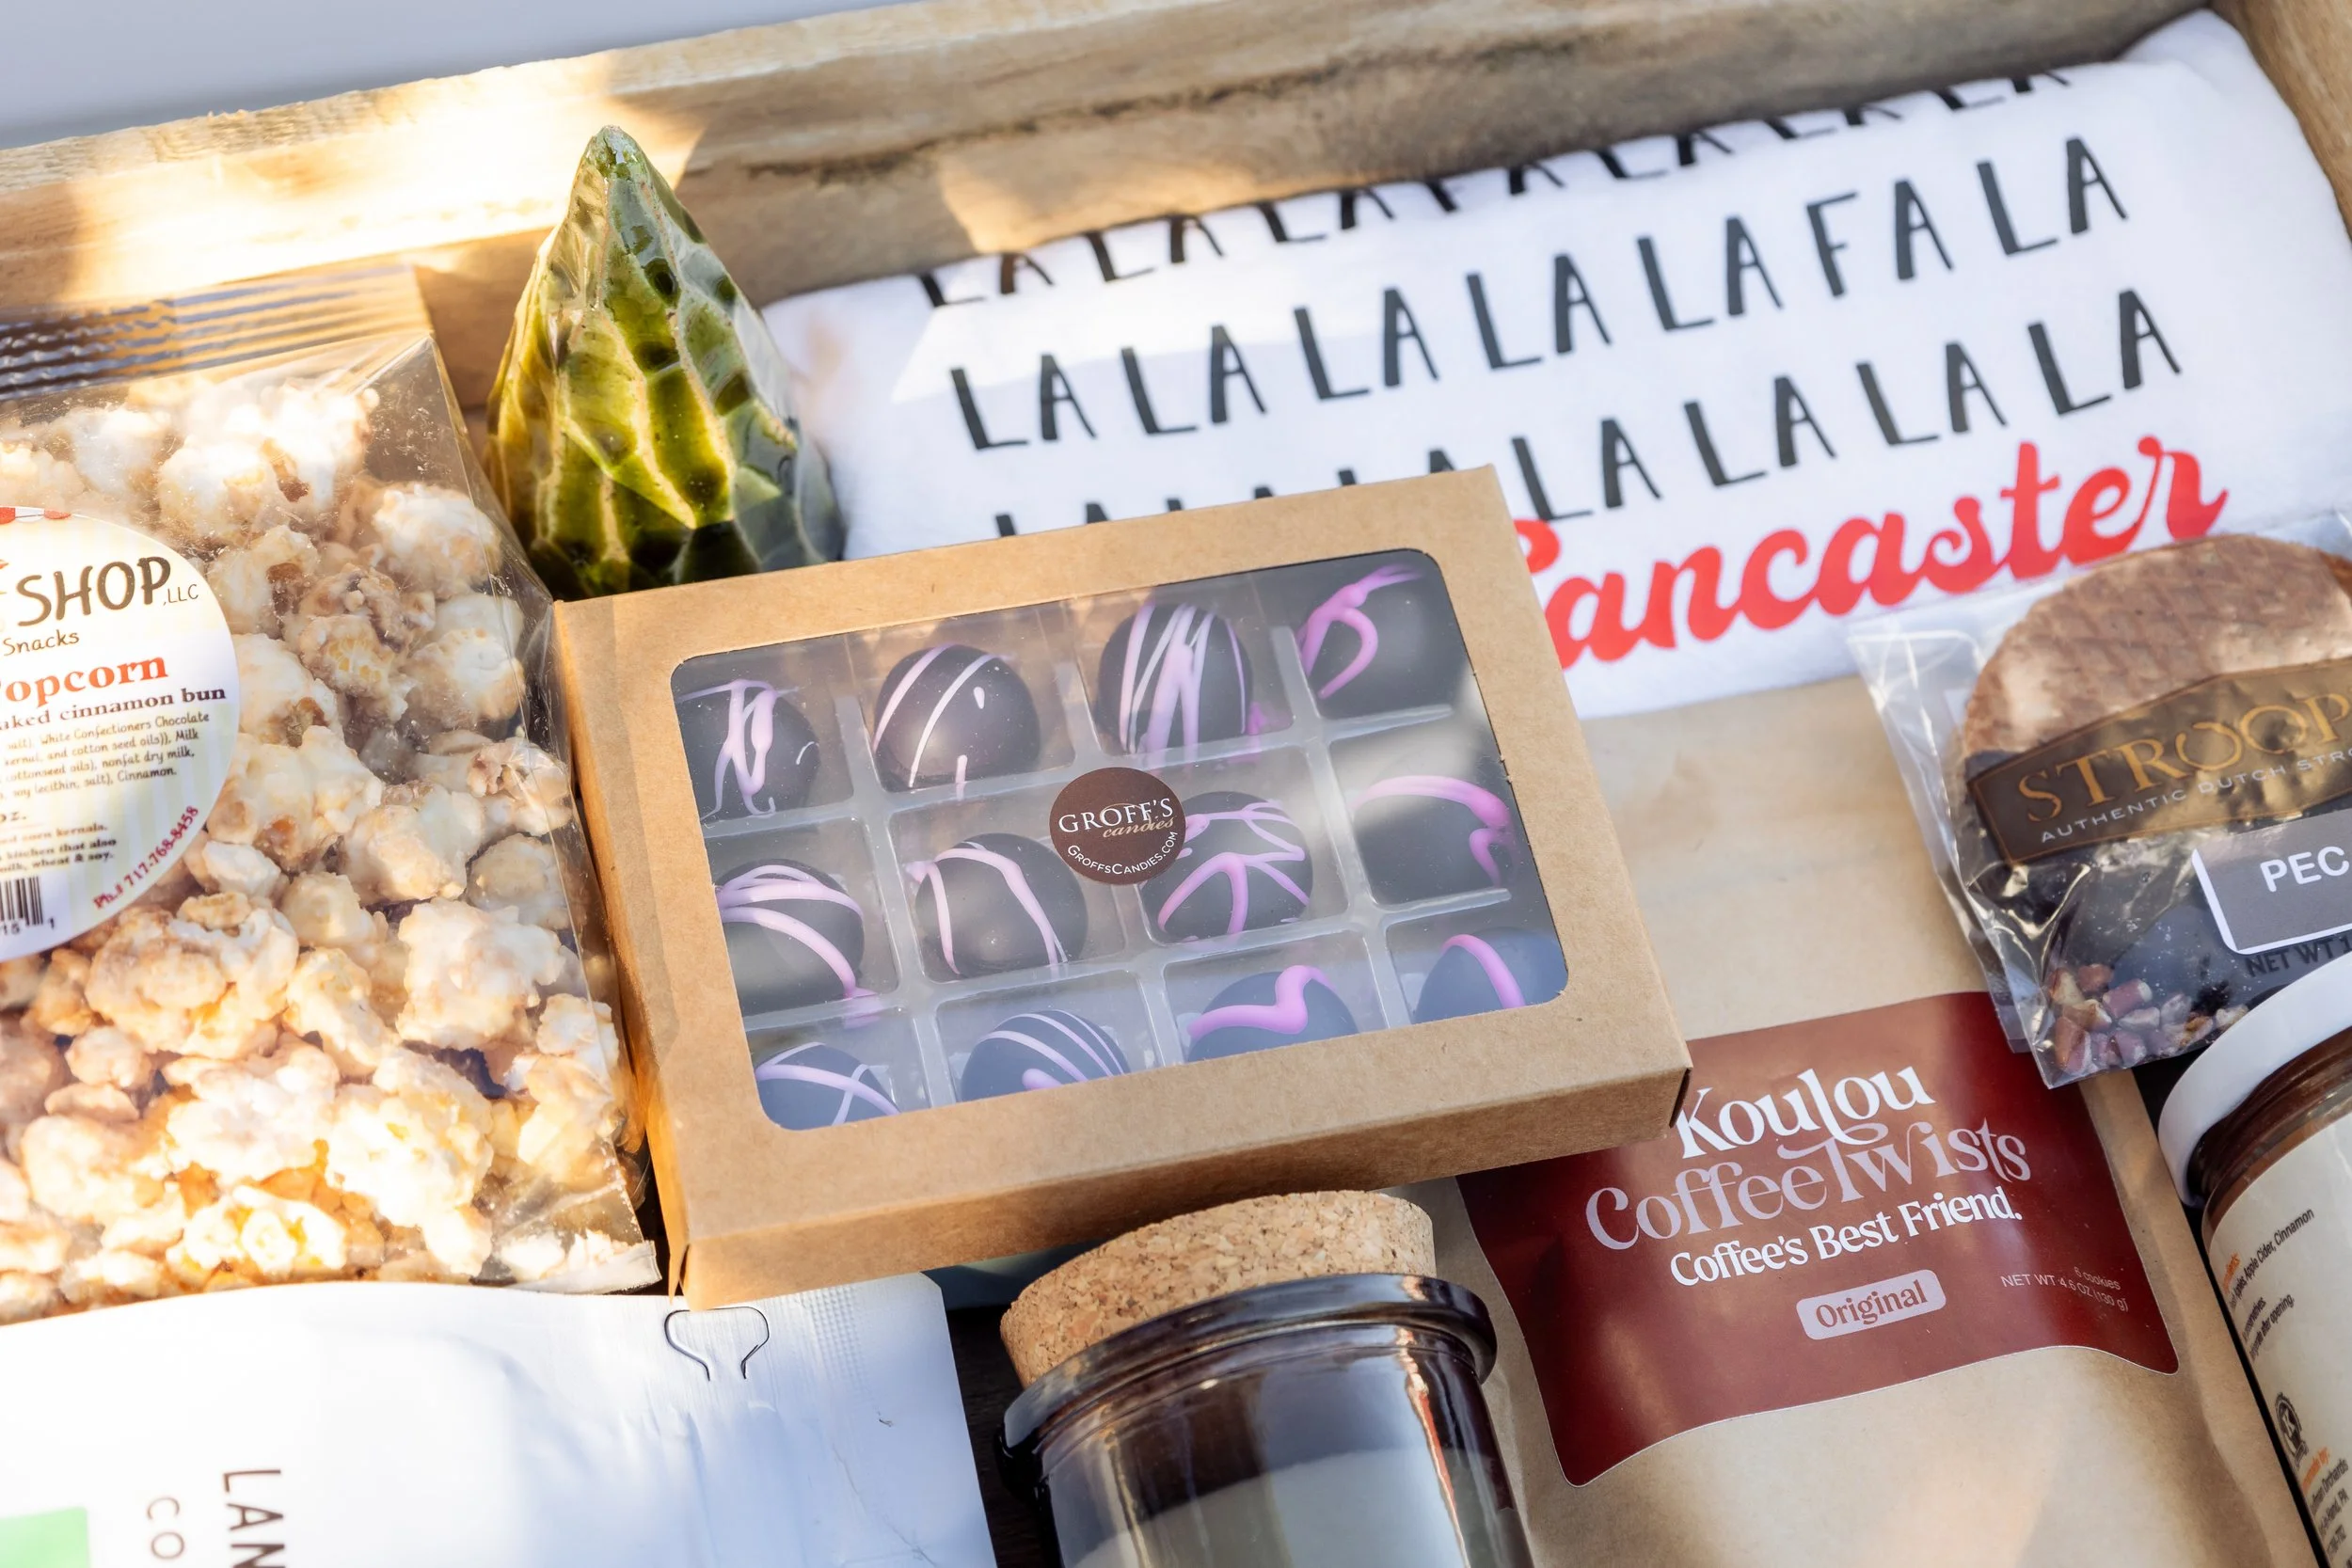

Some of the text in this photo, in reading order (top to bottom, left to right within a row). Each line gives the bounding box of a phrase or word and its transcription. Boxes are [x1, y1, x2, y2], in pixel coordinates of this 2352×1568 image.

[950, 136, 2130, 451] LA LA LA LA LA FA LA
[1510, 417, 1661, 523] LA
[1684, 373, 1836, 488] LA
[1856, 341, 2008, 447] LA
[2026, 288, 2183, 417] LA
[3, 629, 80, 657] Snacks
[0, 657, 168, 708] opcorn
[60, 693, 174, 721] cinnamon
[181, 688, 226, 704] bun
[74, 721, 151, 739] Confectioners
[155, 712, 210, 728] Chocolate
[47, 747, 68, 760] and
[72, 741, 109, 756] cotton
[112, 736, 137, 750] seed
[175, 728, 199, 742] Milk
[102, 753, 141, 769] nonfat
[144, 750, 165, 766] dry
[1058, 798, 1174, 833] GROFF'S
[2040, 787, 2188, 844] AUTHENTIC
[2198, 765, 2287, 795] DUTCH
[1103, 814, 1174, 838] candies
[59, 843, 86, 853] that
[89, 838, 117, 848] also
[2244, 948, 2290, 977] NET
[2294, 938, 2334, 965] WT
[1677, 1066, 1936, 1160] Koulou
[1670, 1185, 2024, 1287] Coffee's Best Friend.
[2256, 1241, 2277, 1264] Cider,
[2273, 1208, 2315, 1246] Cinnamon
[2000, 1274, 2031, 1288] NET
[2034, 1274, 2057, 1286] WT
[2083, 1271, 2122, 1291] cookies
[1815, 1279, 1930, 1330] Original
[2269, 1292, 2296, 1324] opening.
[147, 1496, 185, 1560] CO
